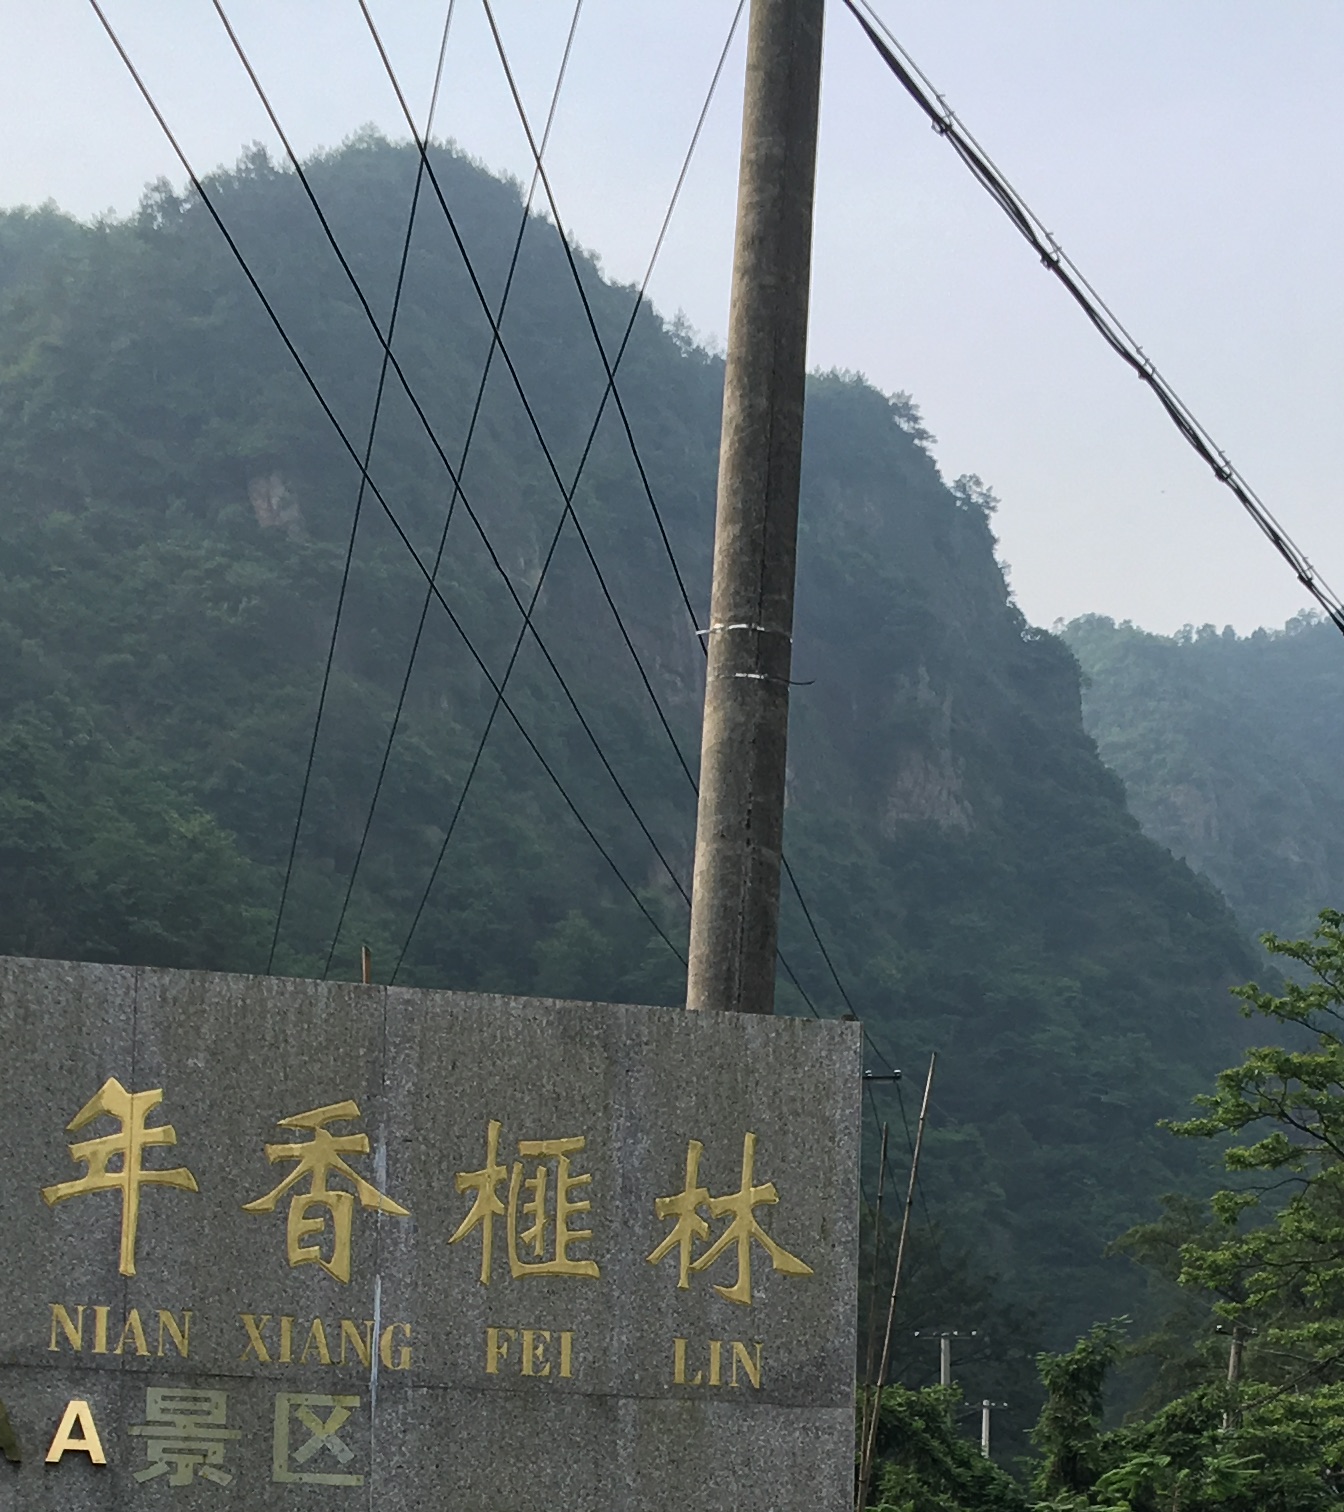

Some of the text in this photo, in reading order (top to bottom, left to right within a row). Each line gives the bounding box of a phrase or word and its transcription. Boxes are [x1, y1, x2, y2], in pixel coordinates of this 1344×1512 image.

[48, 1302, 194, 1360] NIAN
[240, 1314, 413, 1371] XIANG
[485, 1327, 574, 1379] FEI
[674, 1337, 764, 1390] LIN
